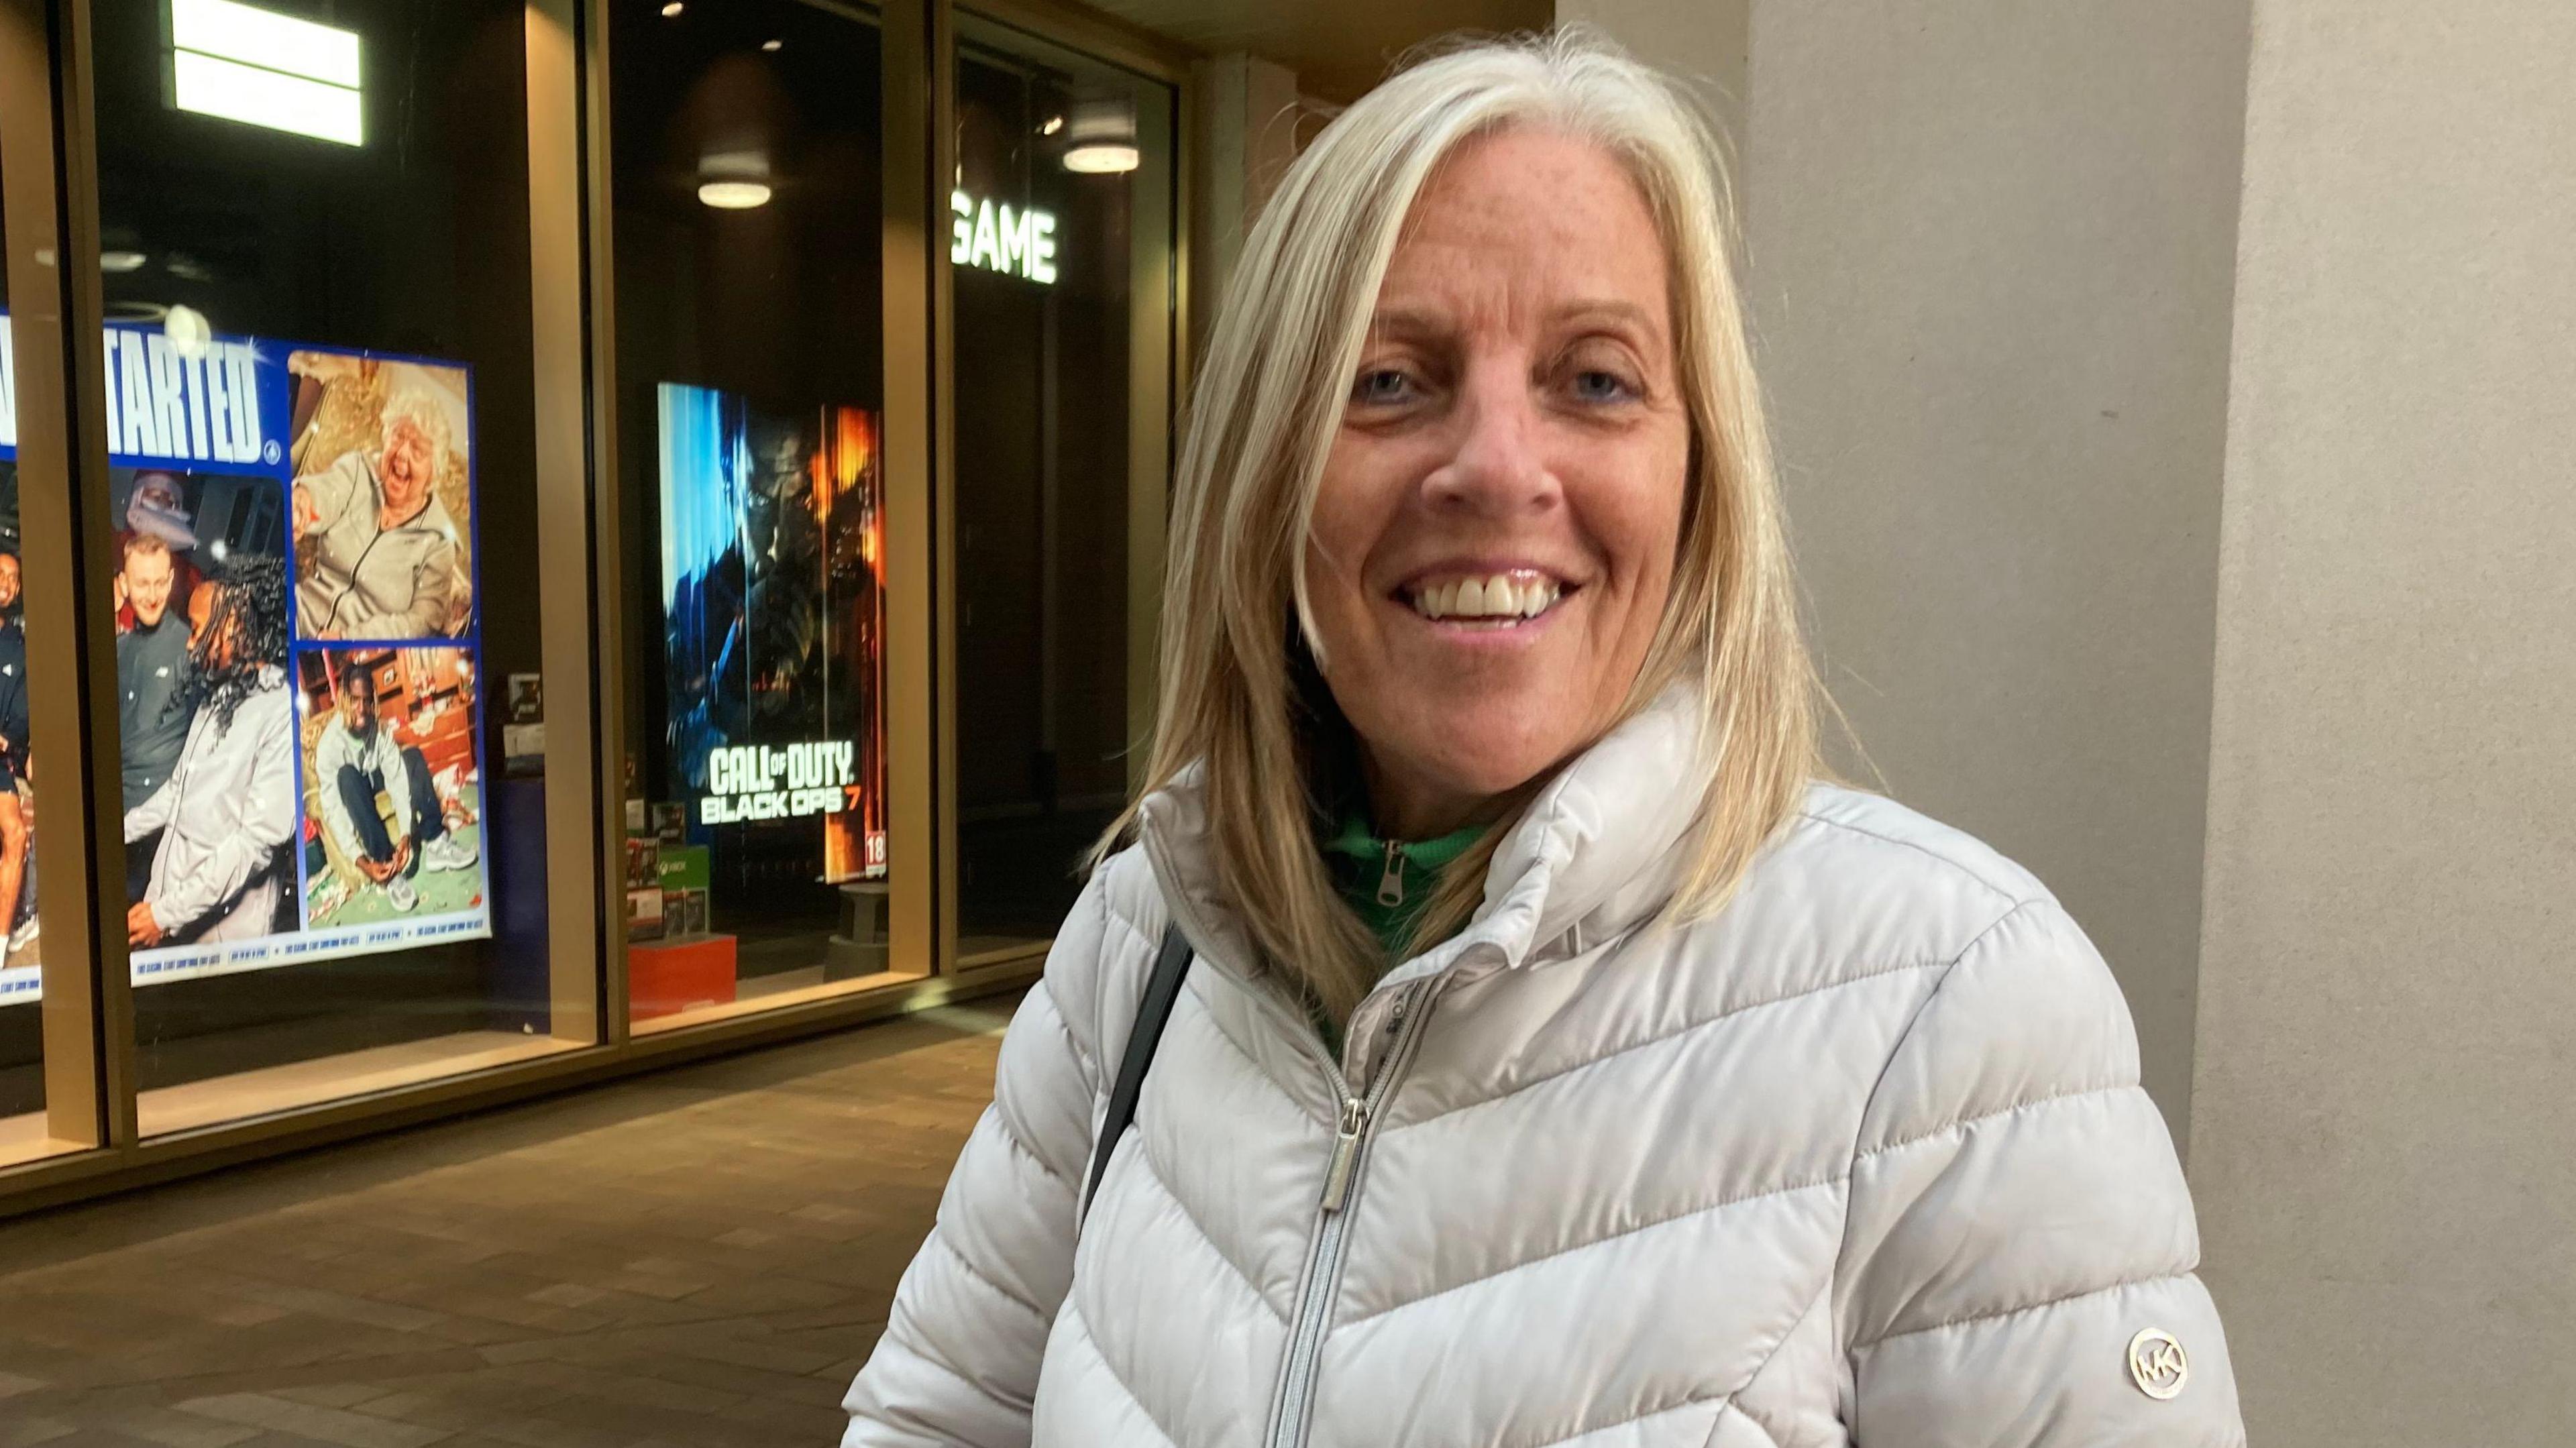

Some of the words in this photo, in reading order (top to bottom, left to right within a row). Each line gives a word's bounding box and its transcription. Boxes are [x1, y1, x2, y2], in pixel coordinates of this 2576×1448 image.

[951, 190, 1057, 284] GAME
[103, 328, 261, 464] TARTED
[710, 745, 775, 795] CALL
[771, 753, 787, 776] OF
[788, 740, 853, 790] DUTY
[701, 790, 789, 825] BLACK
[791, 786, 842, 816] OPS
[845, 785, 861, 810] 7
[867, 836, 883, 863] 18
[2137, 1345, 2181, 1382] MK
